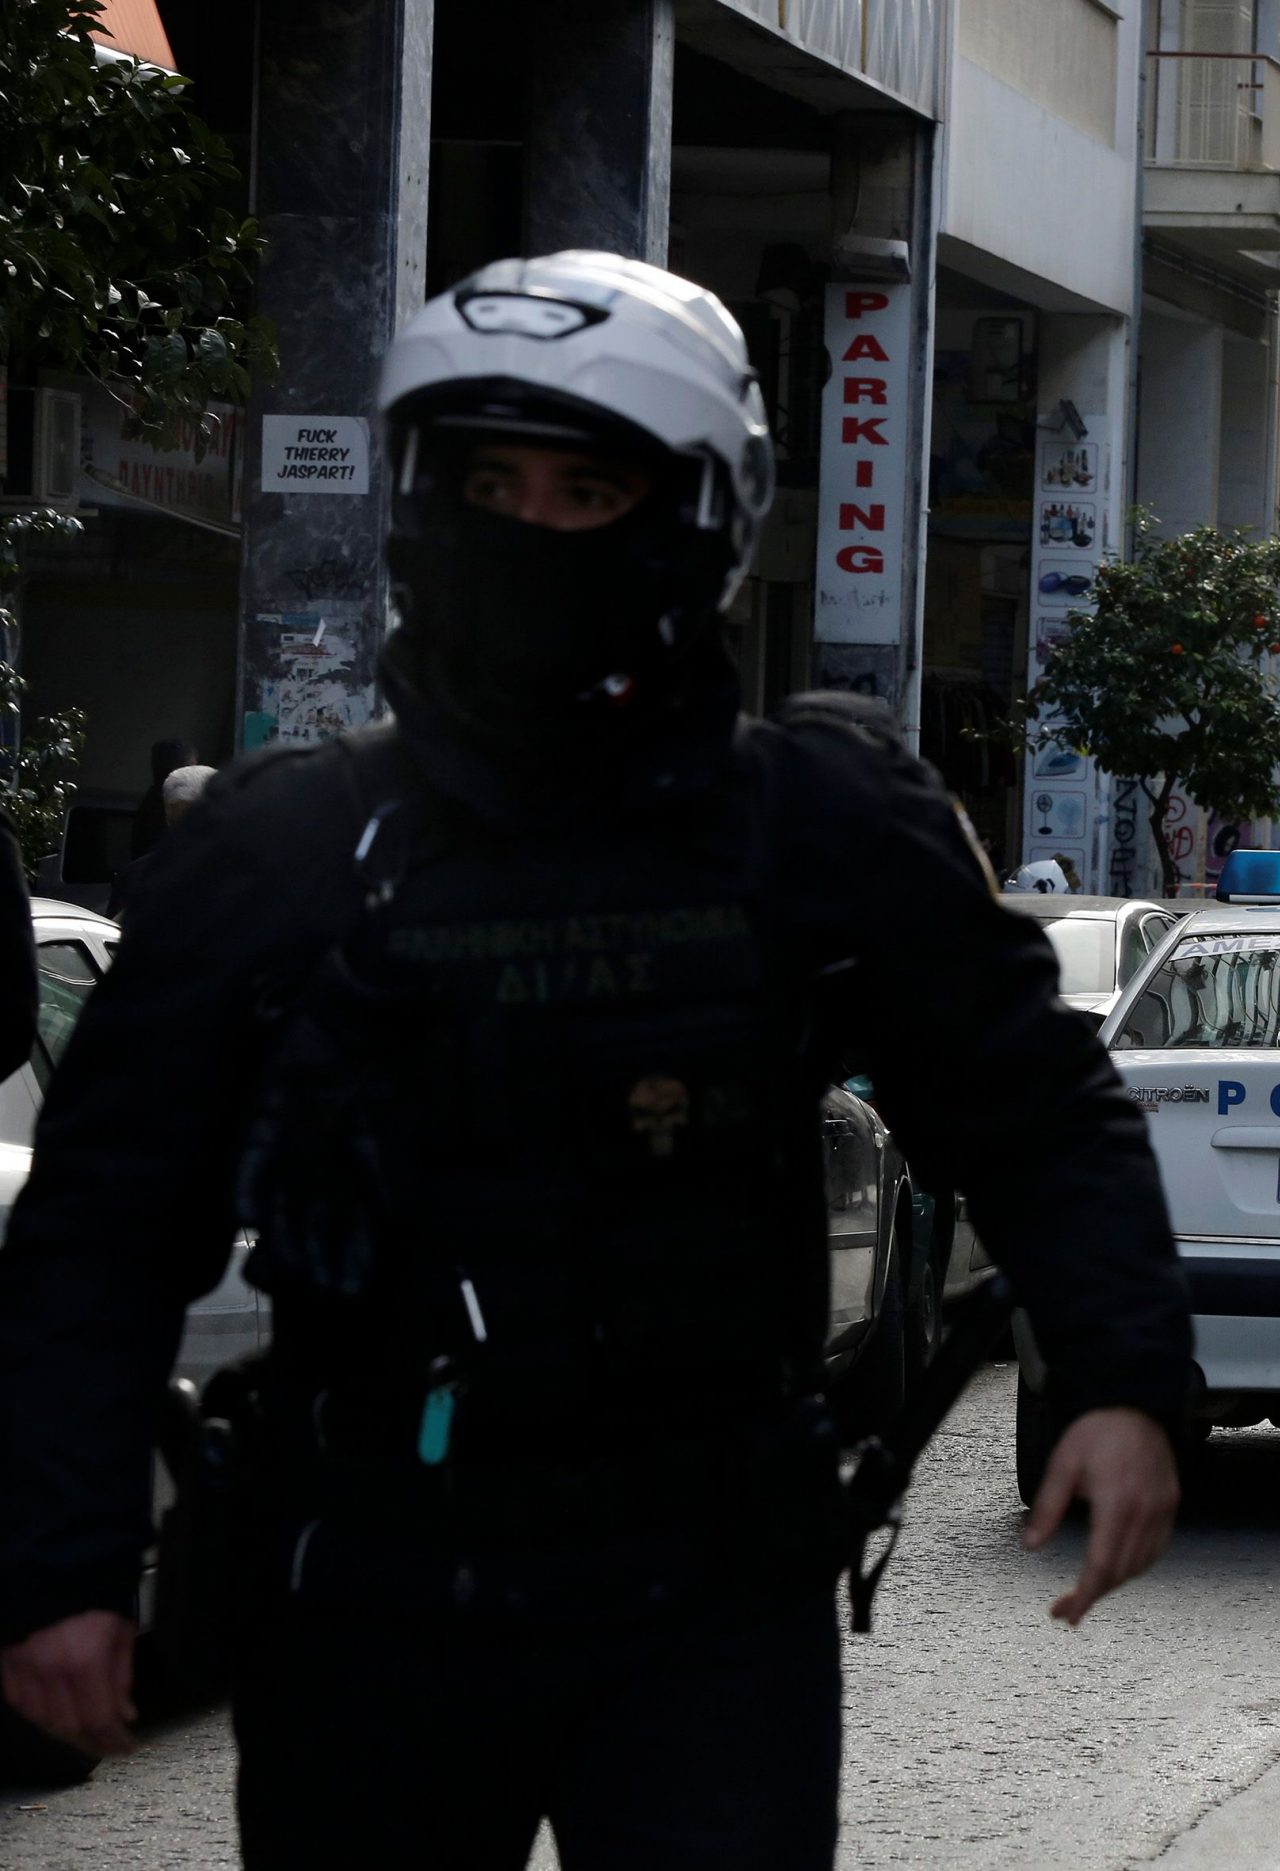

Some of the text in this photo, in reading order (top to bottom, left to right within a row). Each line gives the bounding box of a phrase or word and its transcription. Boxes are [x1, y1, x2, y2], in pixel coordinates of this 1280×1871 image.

[297, 428, 337, 443] FUCK
[835, 290, 890, 574] PARKING
[284, 446, 351, 461] THIERRY
[277, 464, 355, 480] JASPART!
